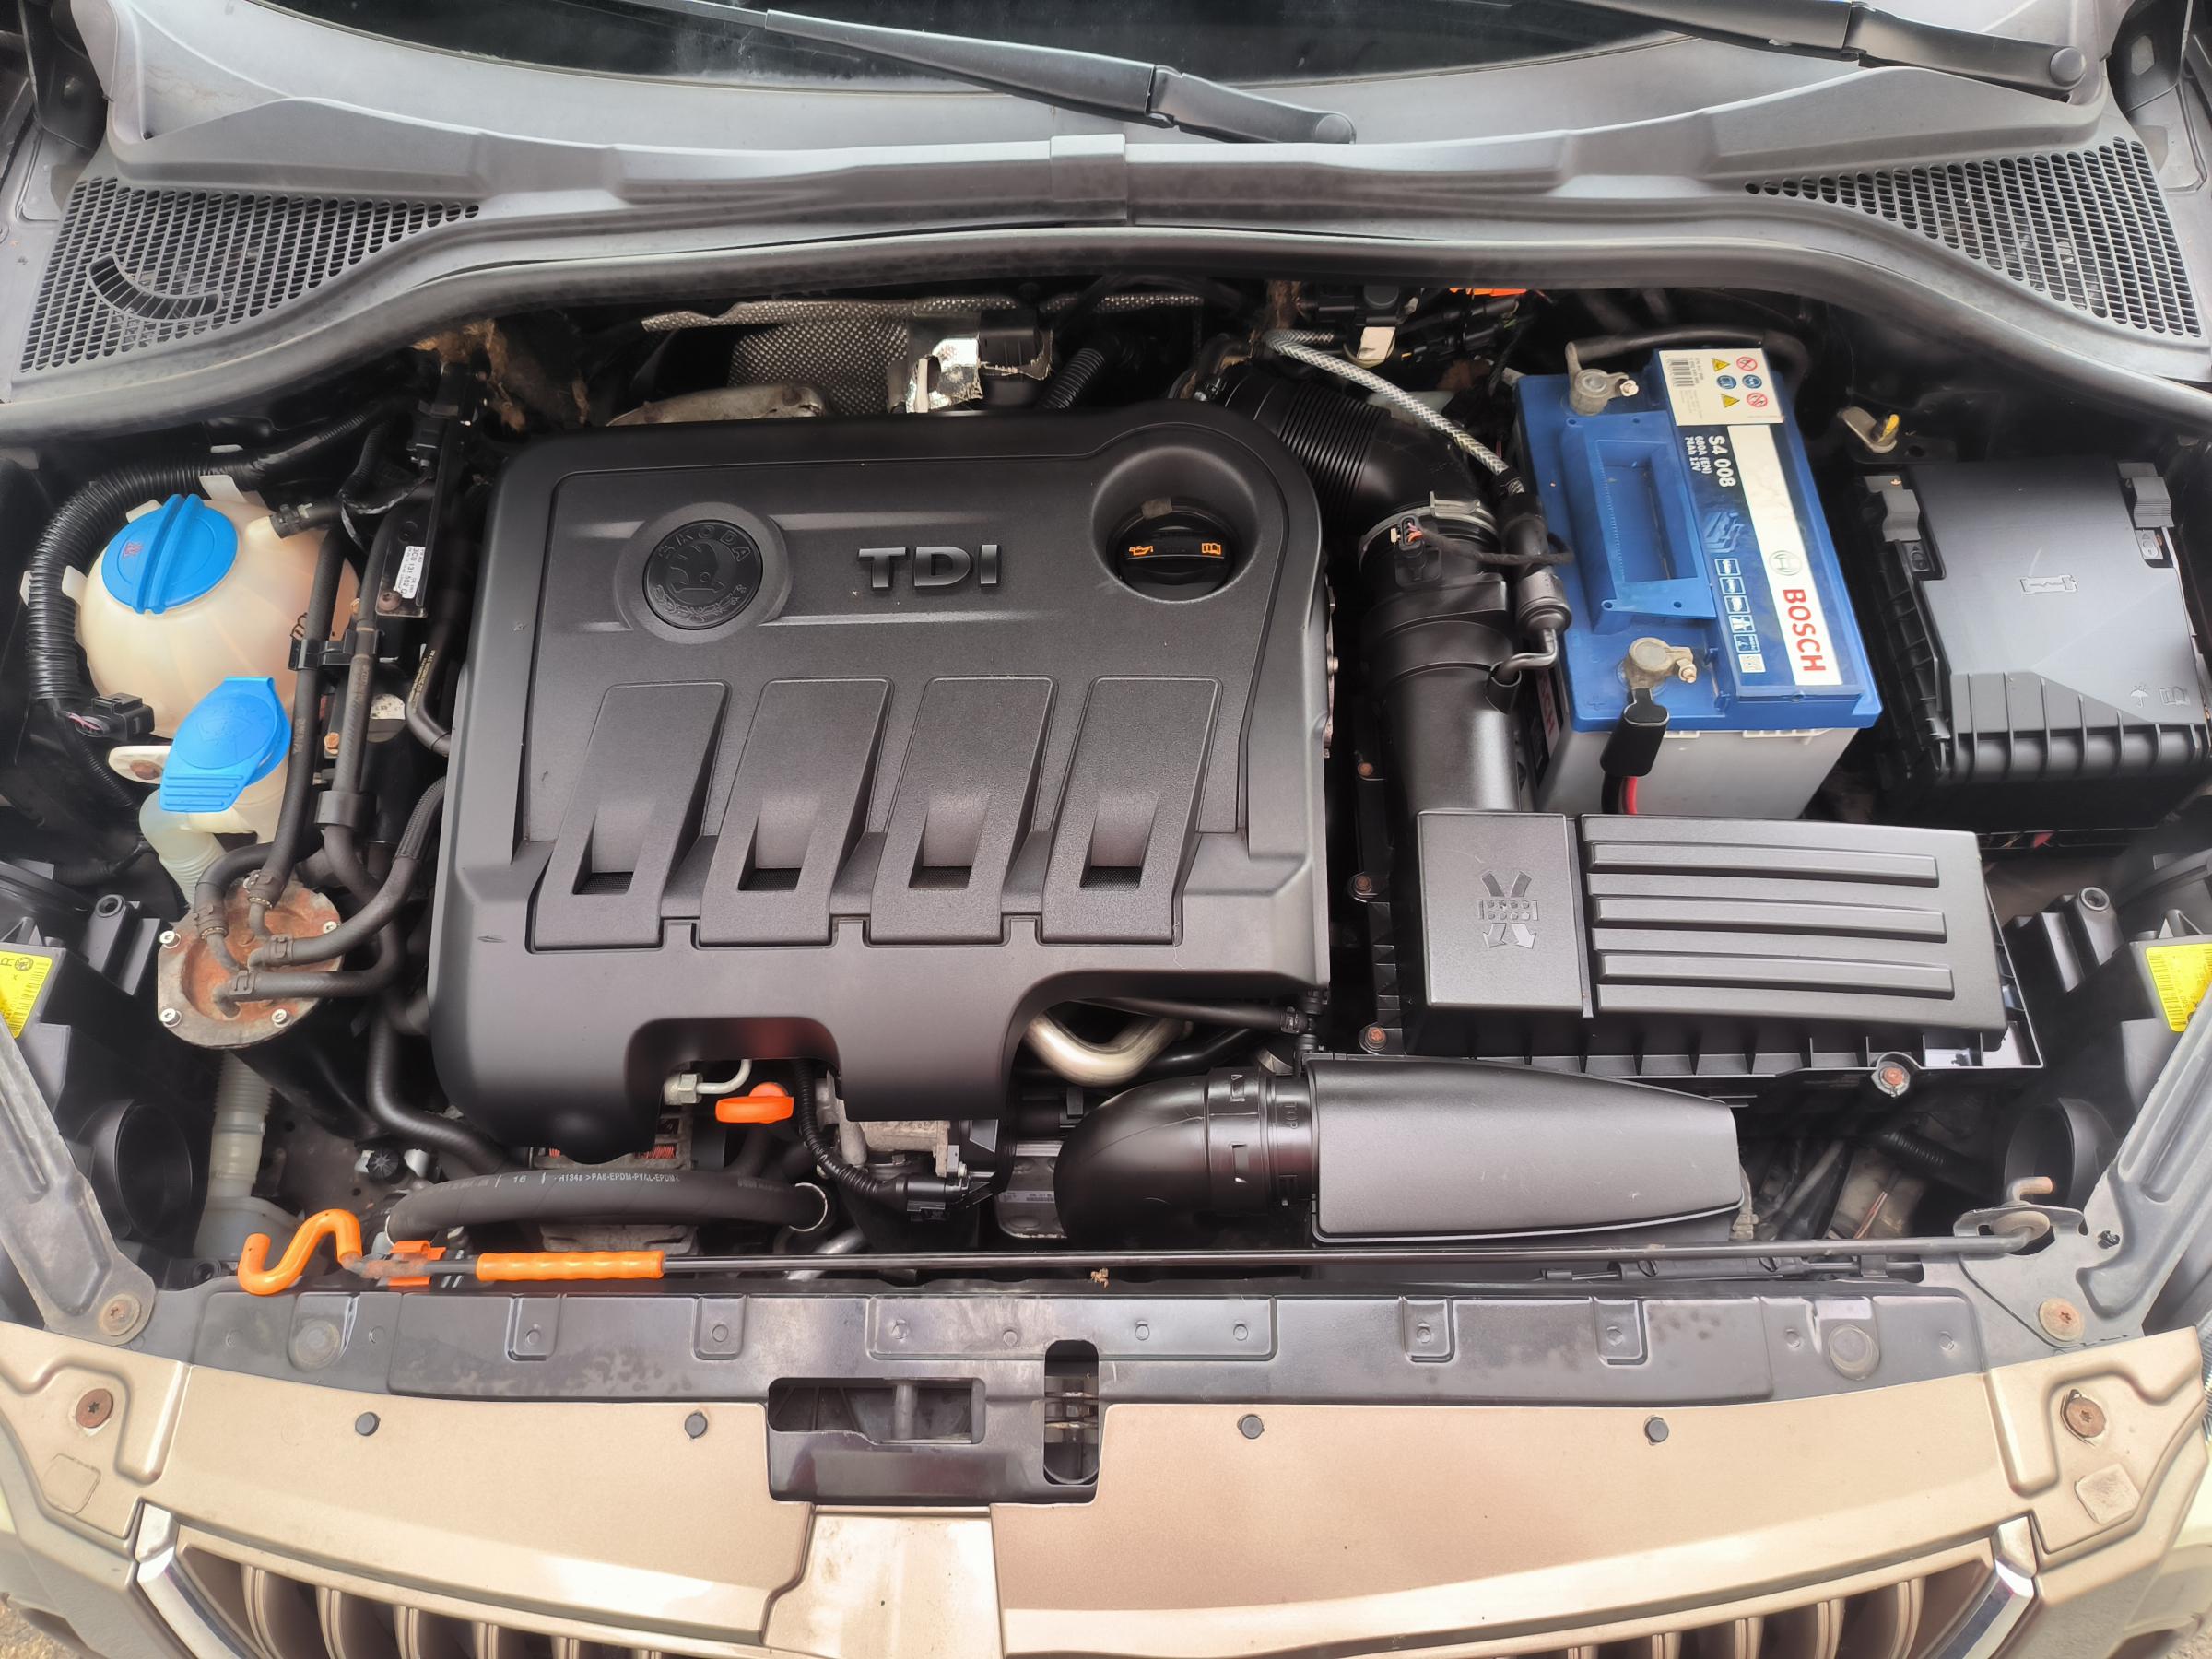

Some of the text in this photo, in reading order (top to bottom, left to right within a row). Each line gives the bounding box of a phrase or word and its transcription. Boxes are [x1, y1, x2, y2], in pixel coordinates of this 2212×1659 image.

[1689, 457, 1701, 471] 12V
[1699, 457, 1712, 474] (EN)
[1708, 435, 1736, 487] S4 008
[858, 543, 998, 588] TDI
[1783, 589, 1826, 671] BOSCH
[1283, 1100, 1299, 1129] TOP
